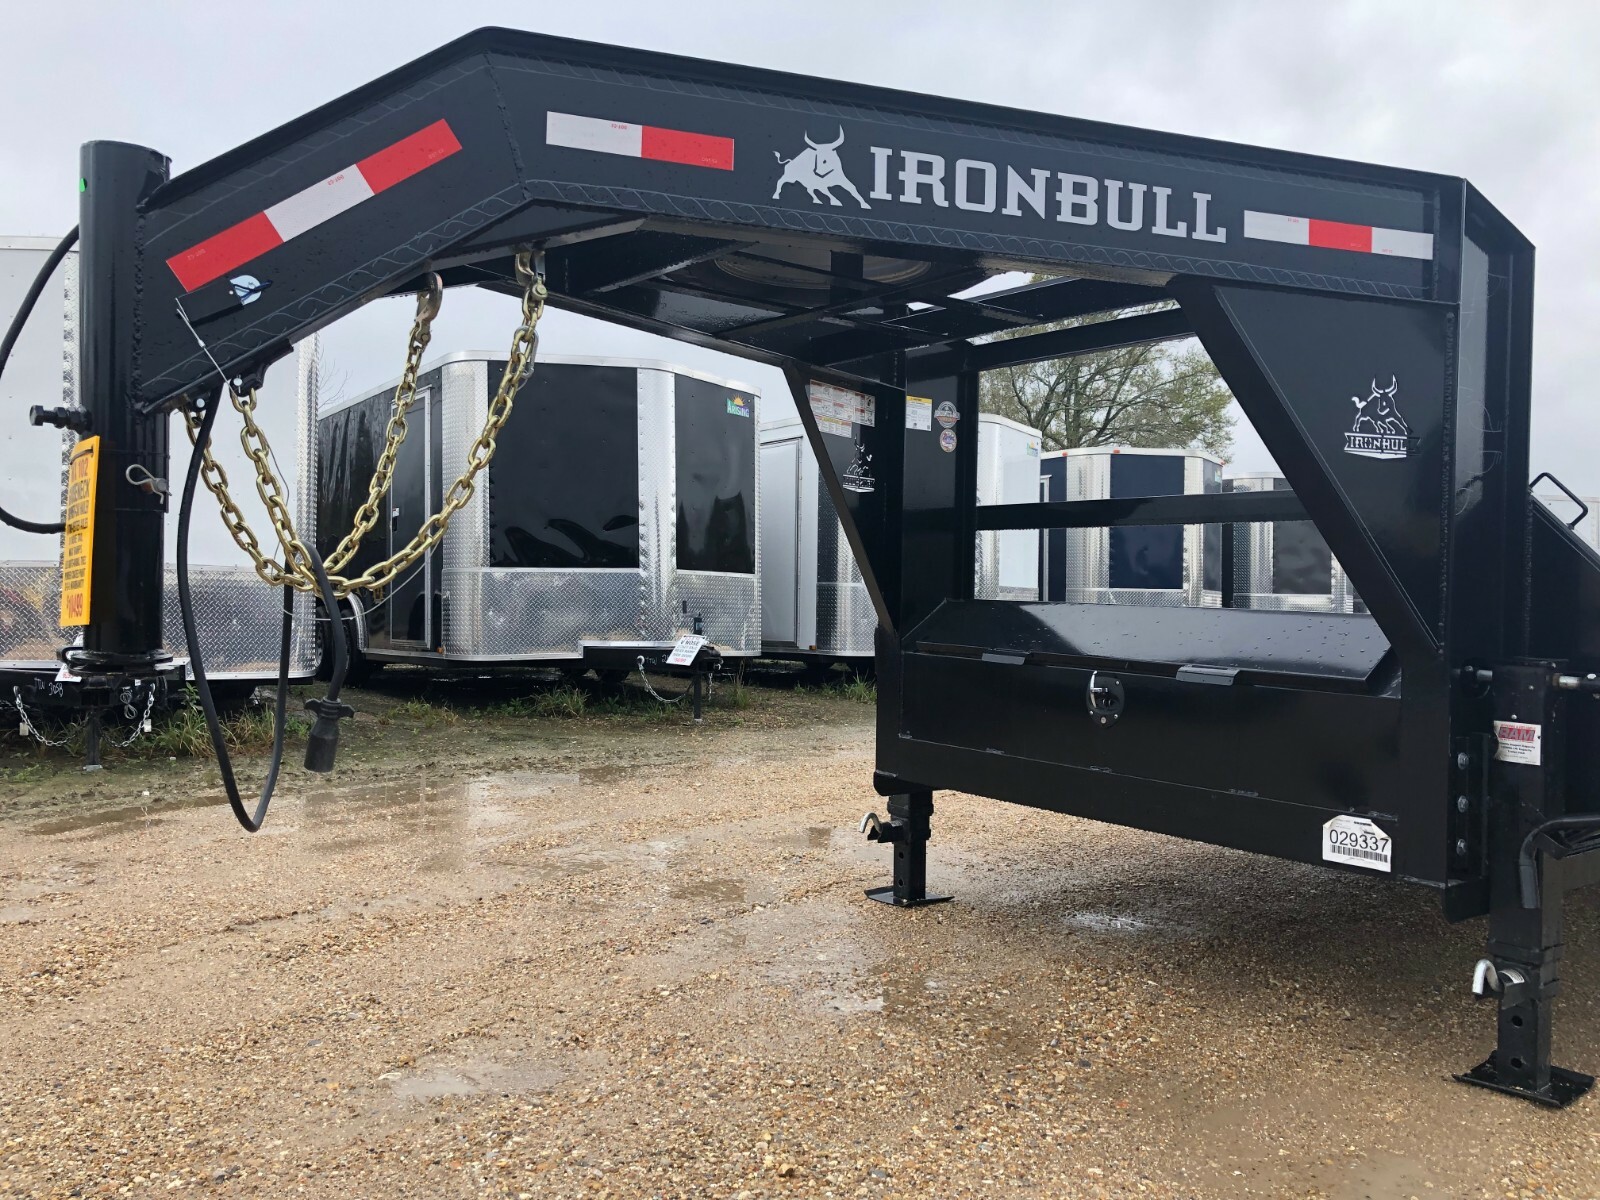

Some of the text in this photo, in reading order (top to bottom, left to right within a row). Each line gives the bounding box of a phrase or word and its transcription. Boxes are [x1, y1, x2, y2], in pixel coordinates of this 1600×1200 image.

[869, 146, 1227, 244] IRONBULL
[1499, 727, 1536, 742] RAM
[1329, 829, 1390, 852] 029337
